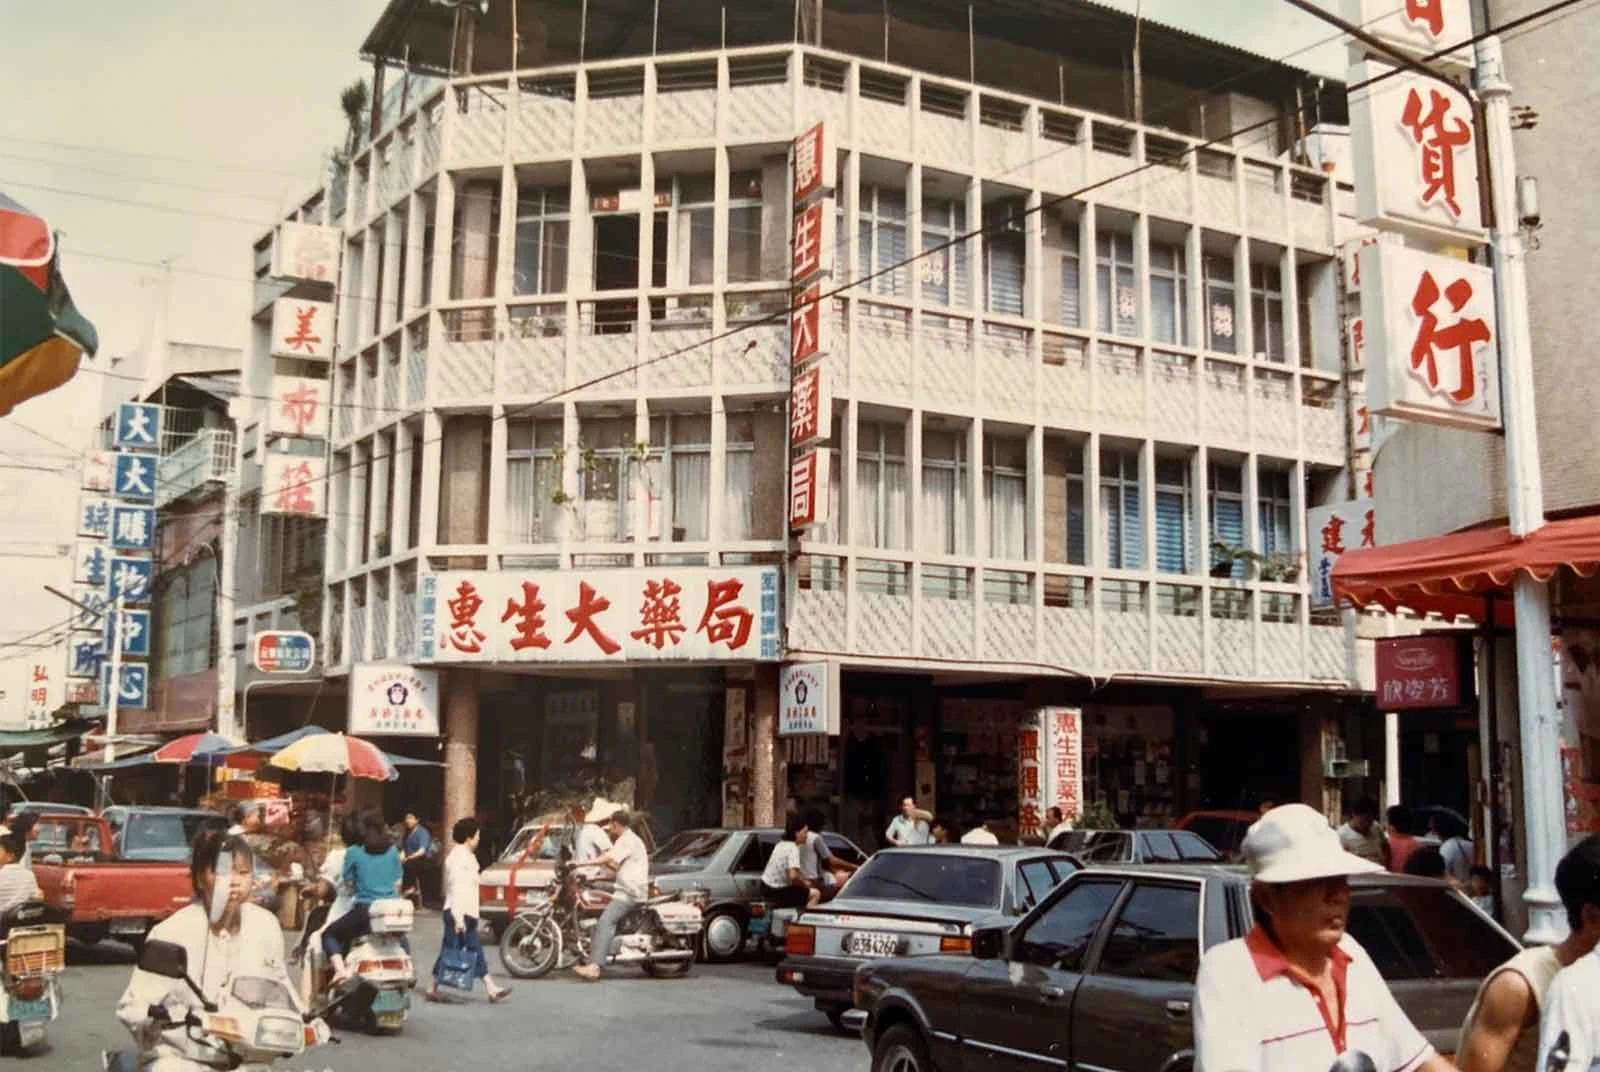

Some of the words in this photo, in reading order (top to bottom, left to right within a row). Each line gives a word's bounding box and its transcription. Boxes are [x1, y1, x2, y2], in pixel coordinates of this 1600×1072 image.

[790, 131, 818, 521] 惠生大藥局
[109, 407, 154, 699] 大大購物中心
[446, 577, 755, 656] 惠生大藥局
